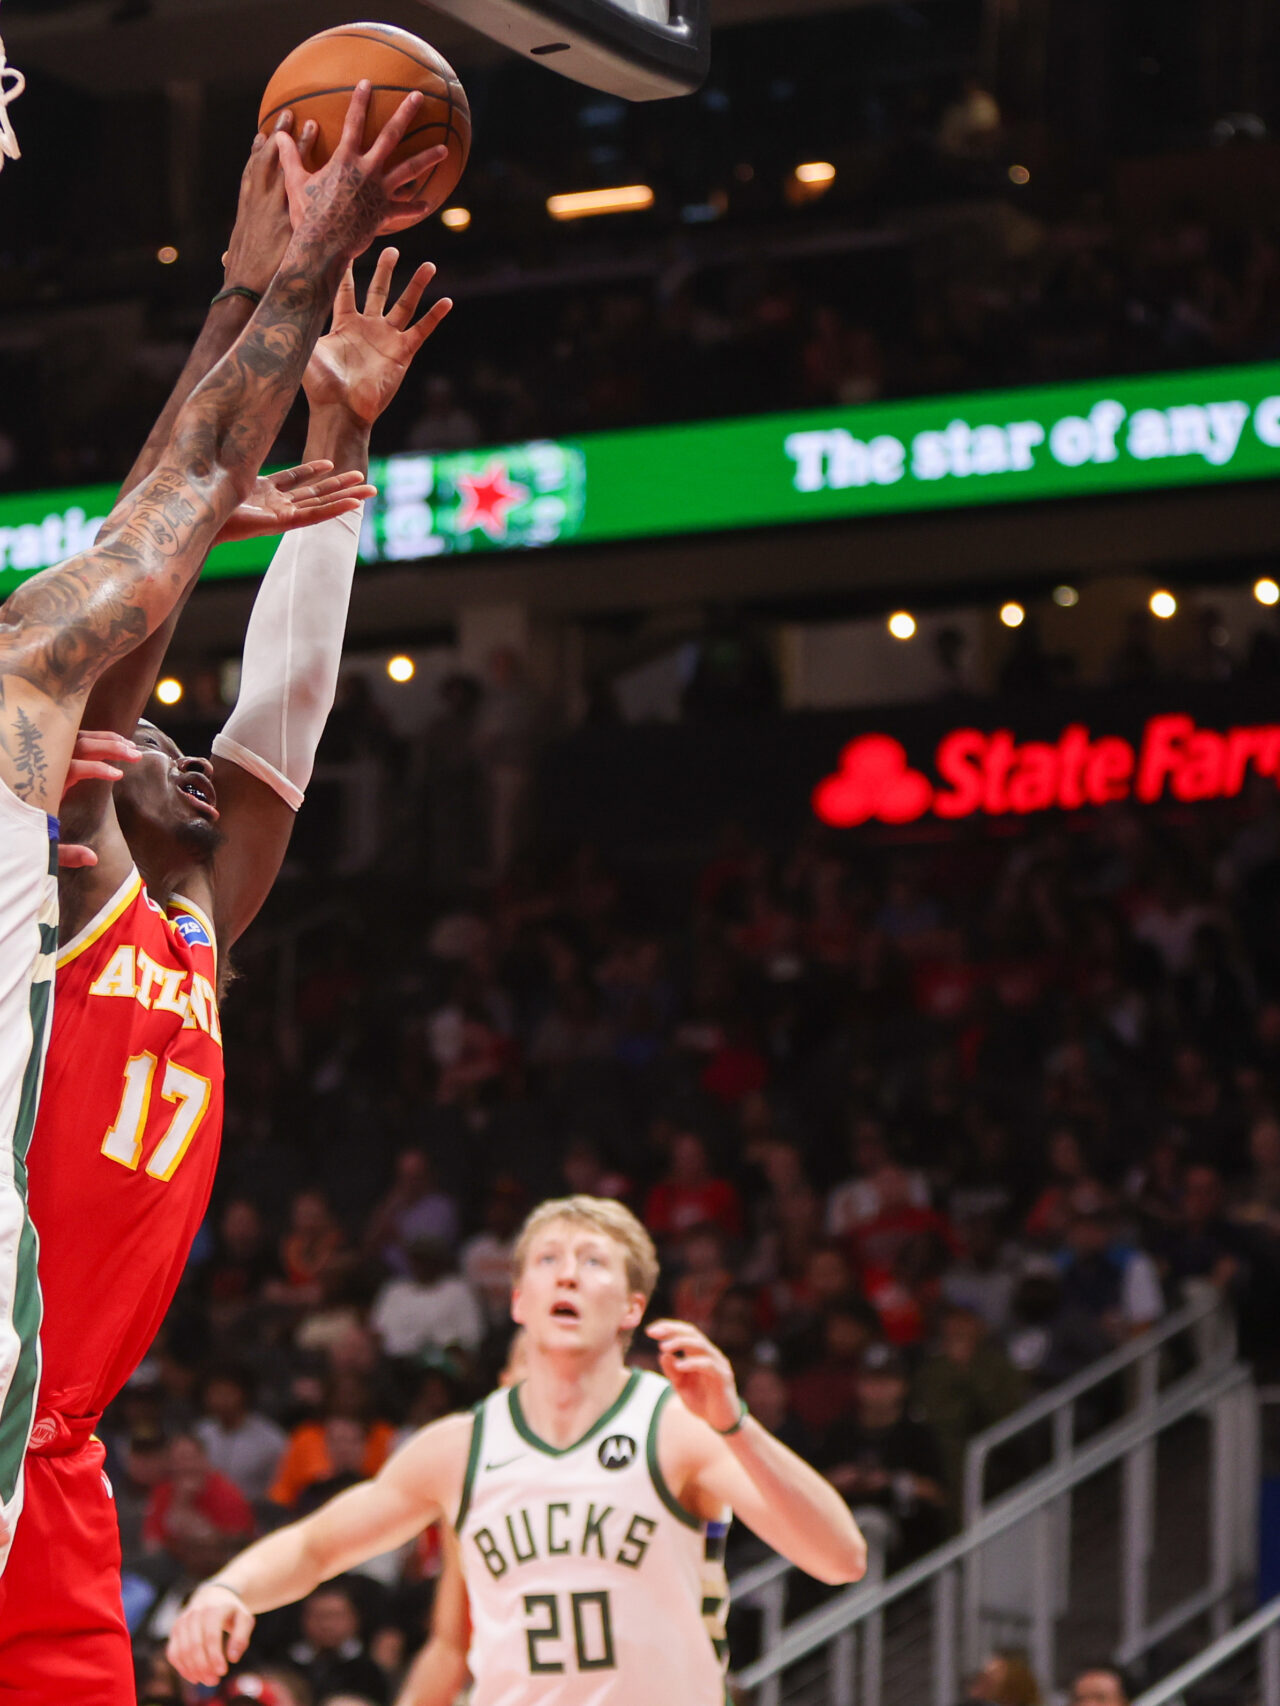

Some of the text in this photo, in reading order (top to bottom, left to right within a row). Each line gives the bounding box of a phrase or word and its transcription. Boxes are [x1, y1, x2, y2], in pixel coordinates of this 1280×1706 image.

[784, 428, 906, 492] The
[910, 419, 1044, 481] star
[1049, 399, 1127, 467] of
[1126, 400, 1249, 466] any
[931, 711, 1280, 820] State Far
[100, 1049, 211, 1182] 17
[474, 1503, 657, 1581] BUCKS
[523, 1590, 617, 1675] 20
